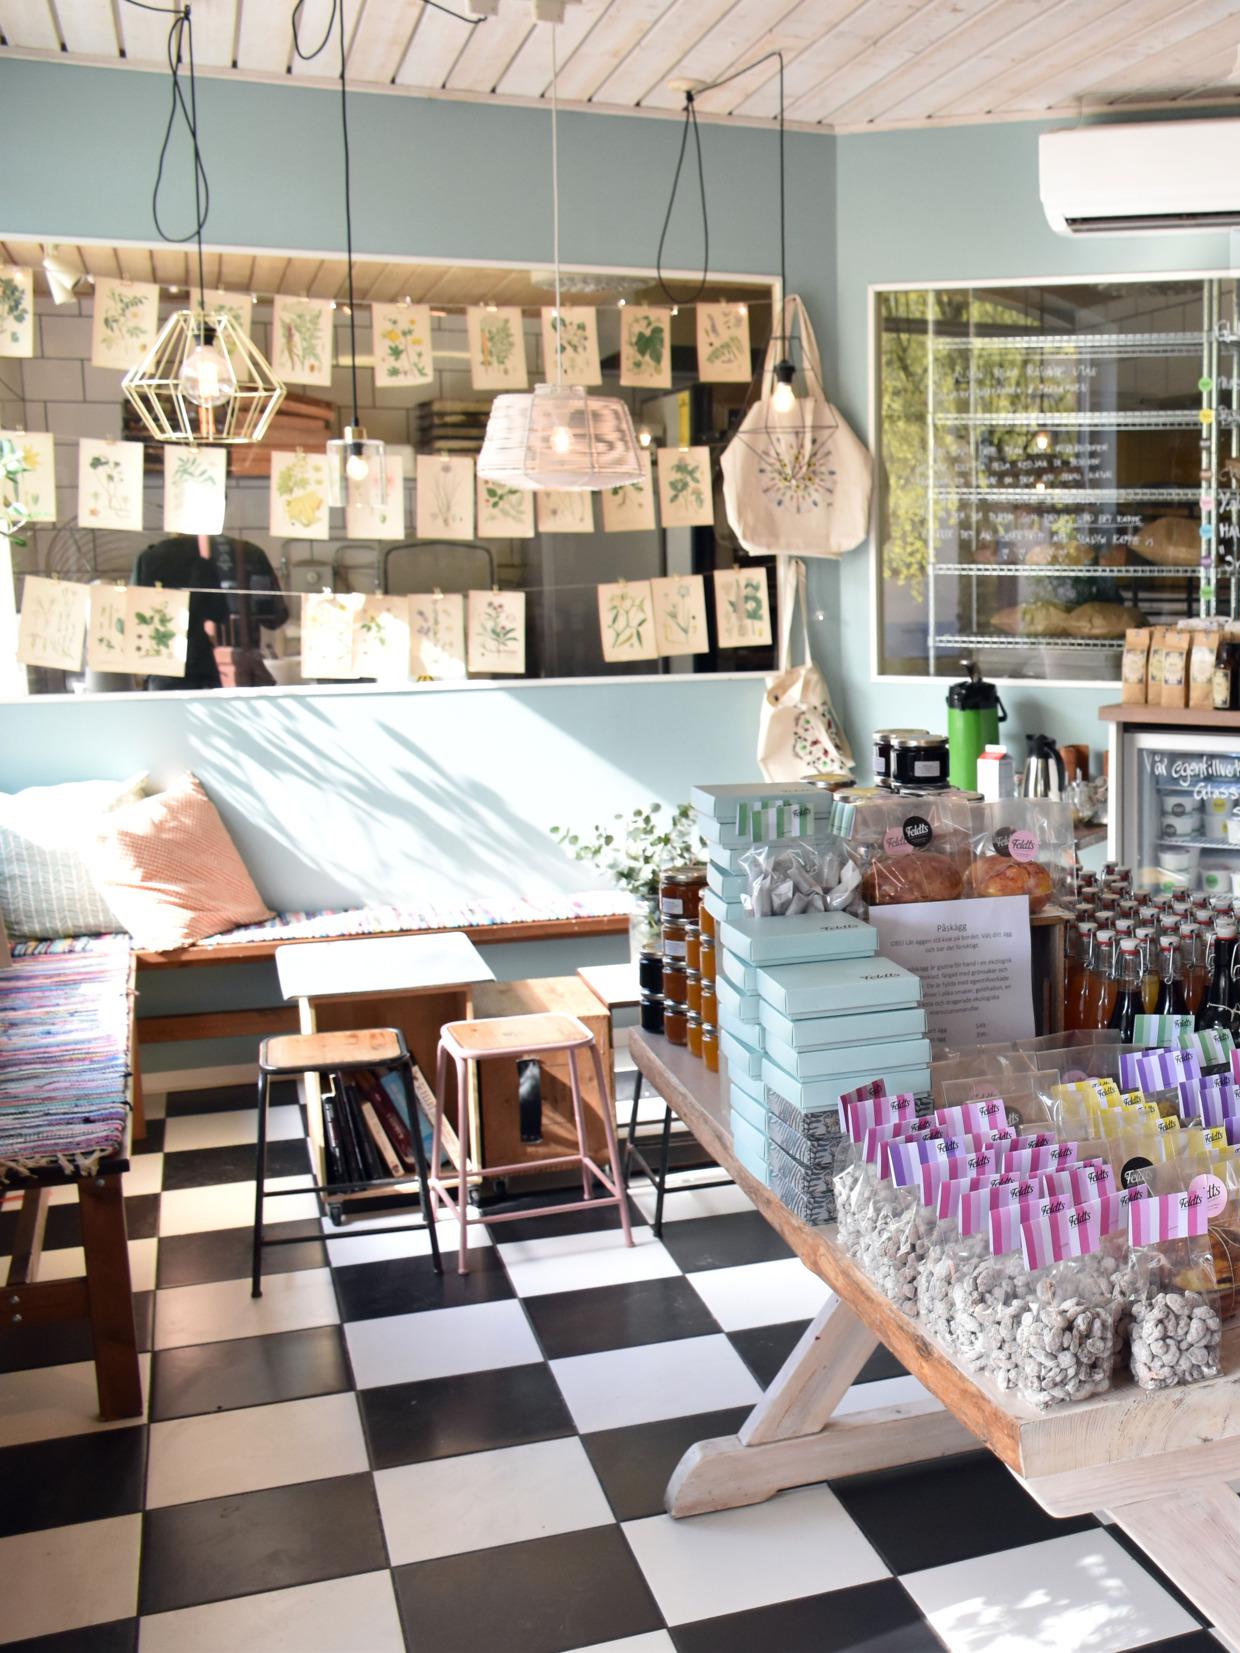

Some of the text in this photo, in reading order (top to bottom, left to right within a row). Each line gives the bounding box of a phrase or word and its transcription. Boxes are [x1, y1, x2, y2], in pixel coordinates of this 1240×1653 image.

[905, 823, 929, 840] Feldts
[1011, 839, 1035, 852] Feldts
[891, 1099, 911, 1111] Feldts
[980, 1103, 1000, 1116] Feldts
[937, 1140, 960, 1154] Feldts
[1050, 1147, 1073, 1160] Feldts
[969, 1154, 991, 1170] Feldts
[1088, 1170, 1110, 1183] Feldts
[1011, 1183, 1034, 1199] Feldts
[1041, 1200, 1066, 1216] Feldts
[1180, 1195, 1203, 1209] Feldts
[1068, 1210, 1092, 1227] Feldts
